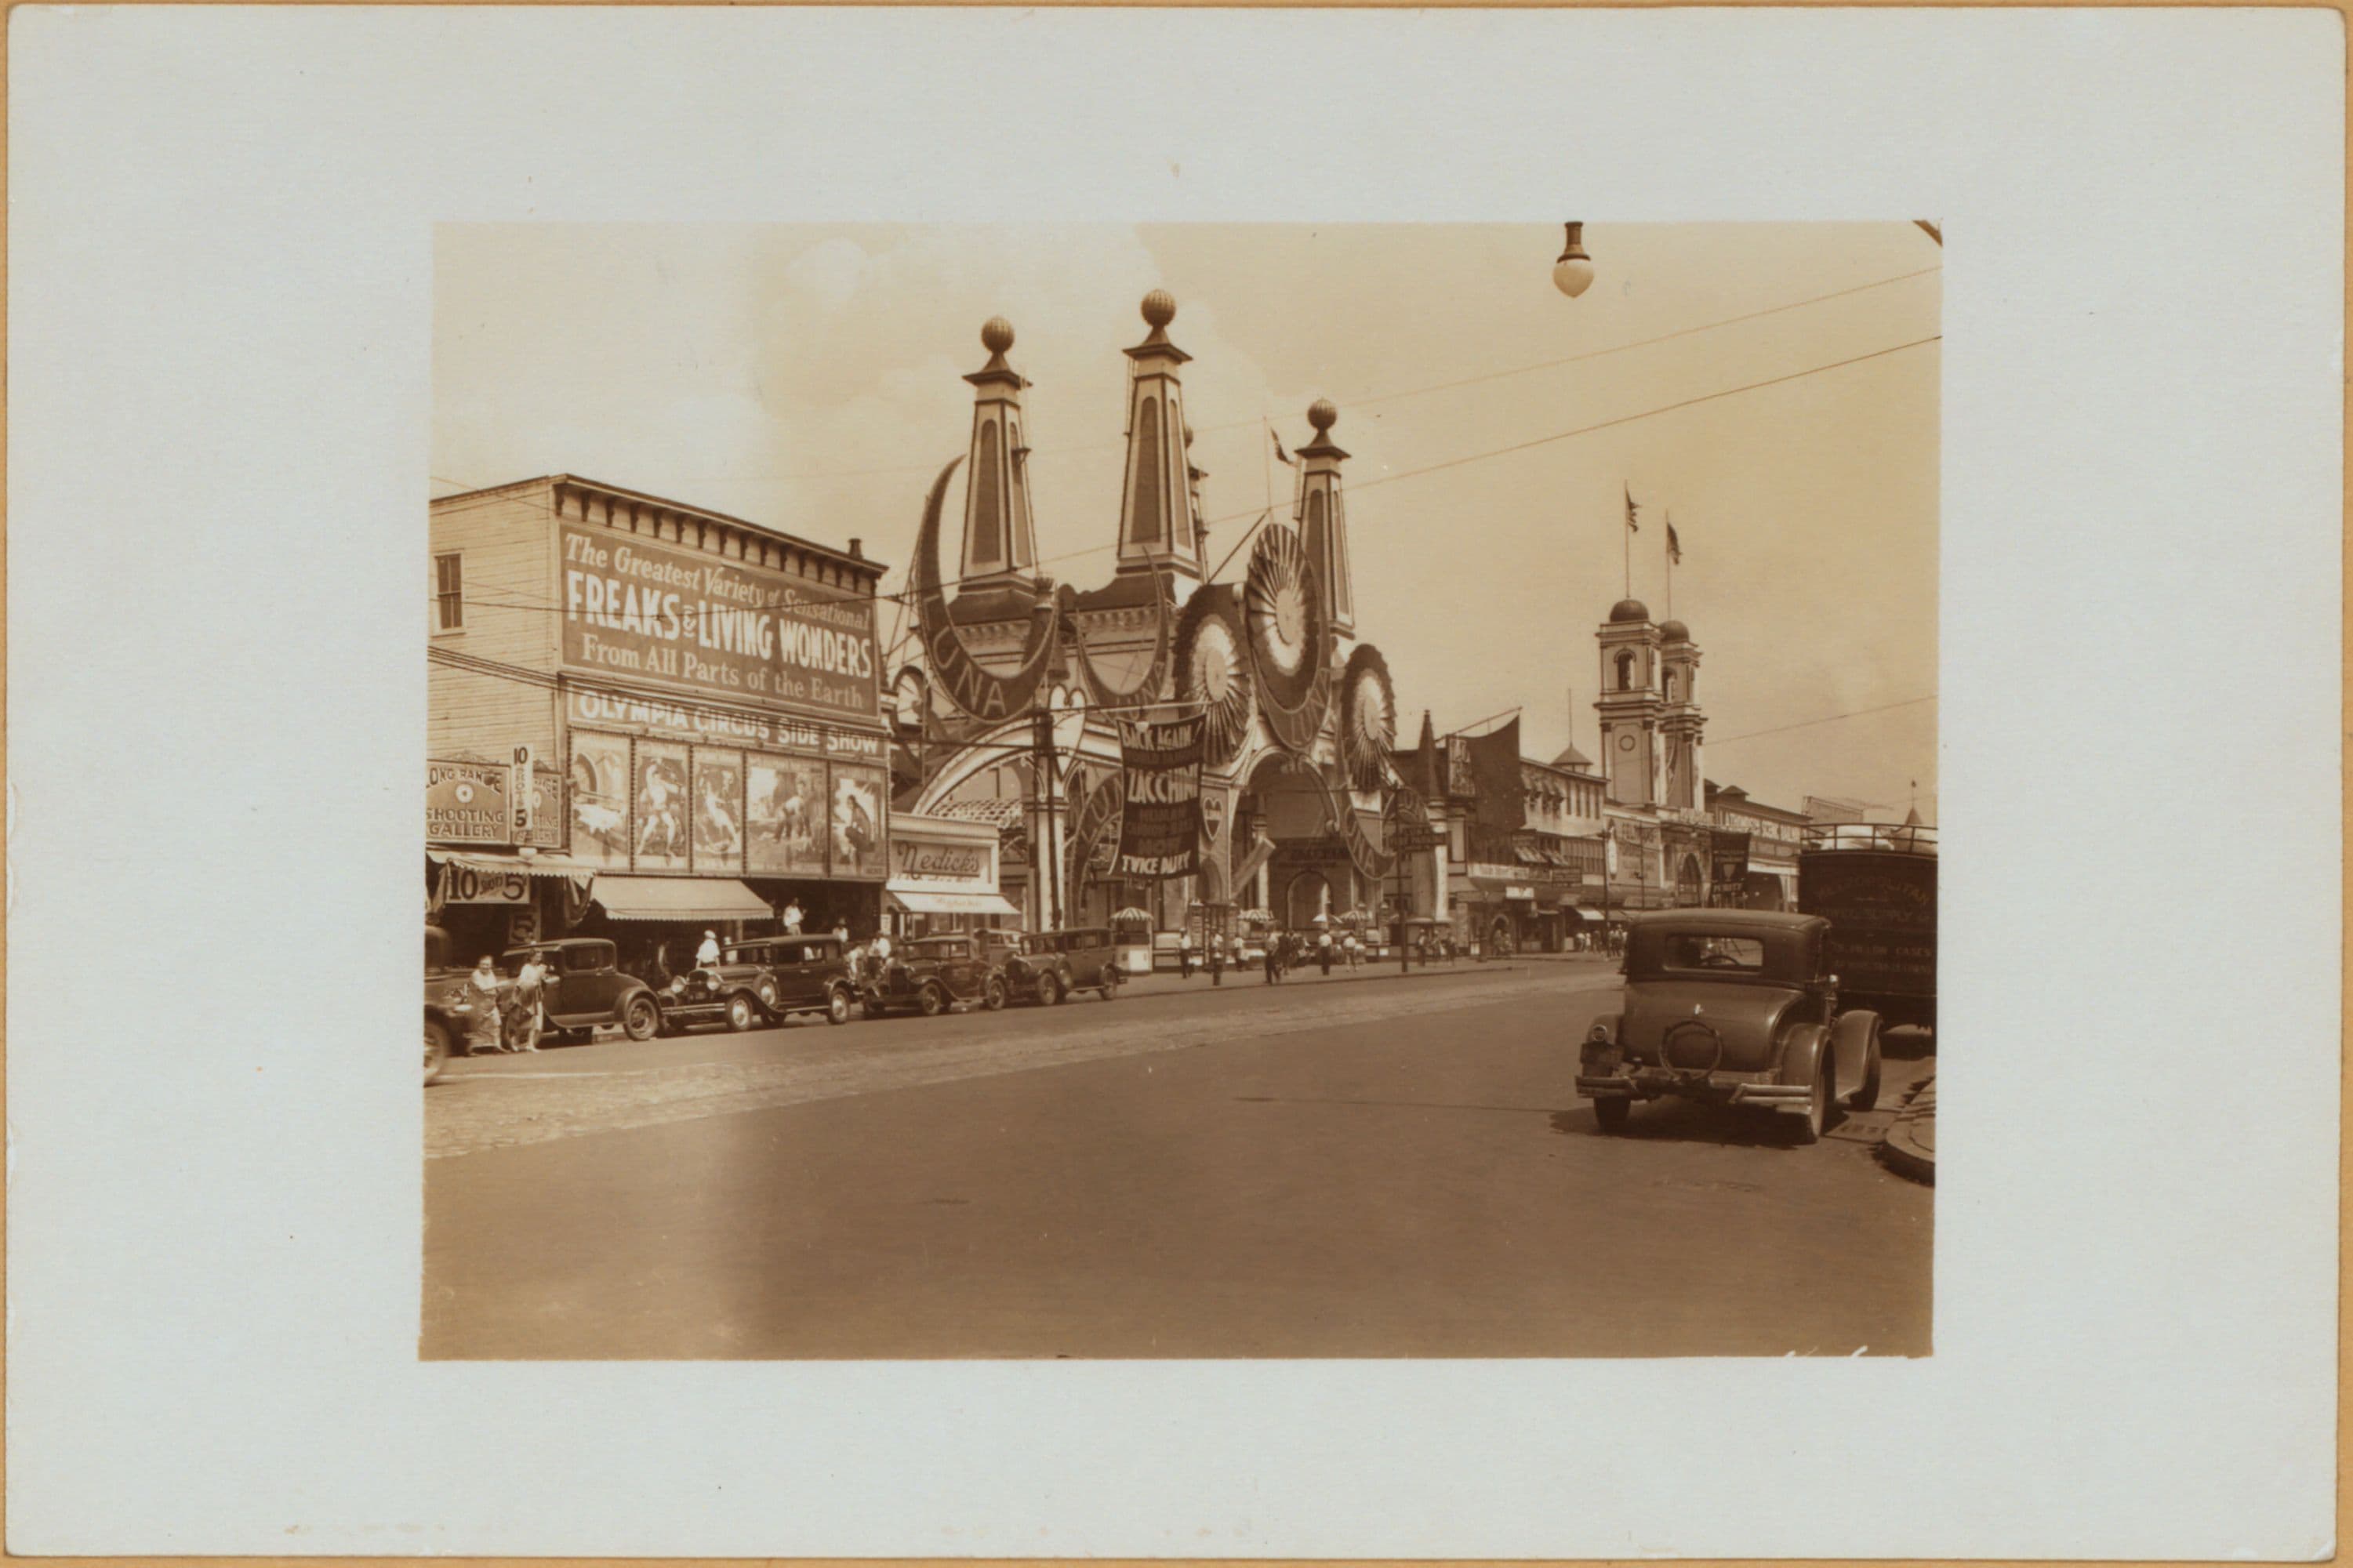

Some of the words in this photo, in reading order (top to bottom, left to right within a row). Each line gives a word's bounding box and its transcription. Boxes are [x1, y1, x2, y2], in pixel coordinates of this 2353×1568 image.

[565, 532, 608, 568] The
[614, 546, 700, 590] Greatest
[704, 567, 764, 608] Variety
[768, 589, 781, 606] of
[783, 590, 871, 630] Sensational
[568, 570, 680, 640] FREAKS
[699, 600, 773, 661] LIVING
[779, 618, 871, 678] WONDERS
[582, 633, 640, 670] From
[646, 645, 678, 676] All
[683, 652, 739, 687] Parts
[747, 667, 769, 690] of
[775, 672, 804, 699] the
[811, 681, 862, 708] Earth
[579, 690, 688, 729] OLYMPIA
[694, 706, 770, 739] CIRCUS
[778, 717, 820, 746] SIDE
[826, 726, 879, 755] SHOW
[514, 746, 528, 764] 10
[426, 808, 503, 822] SHOOTING
[427, 824, 498, 837] GALLERY
[514, 809, 528, 828] 5
[447, 869, 478, 900] 10
